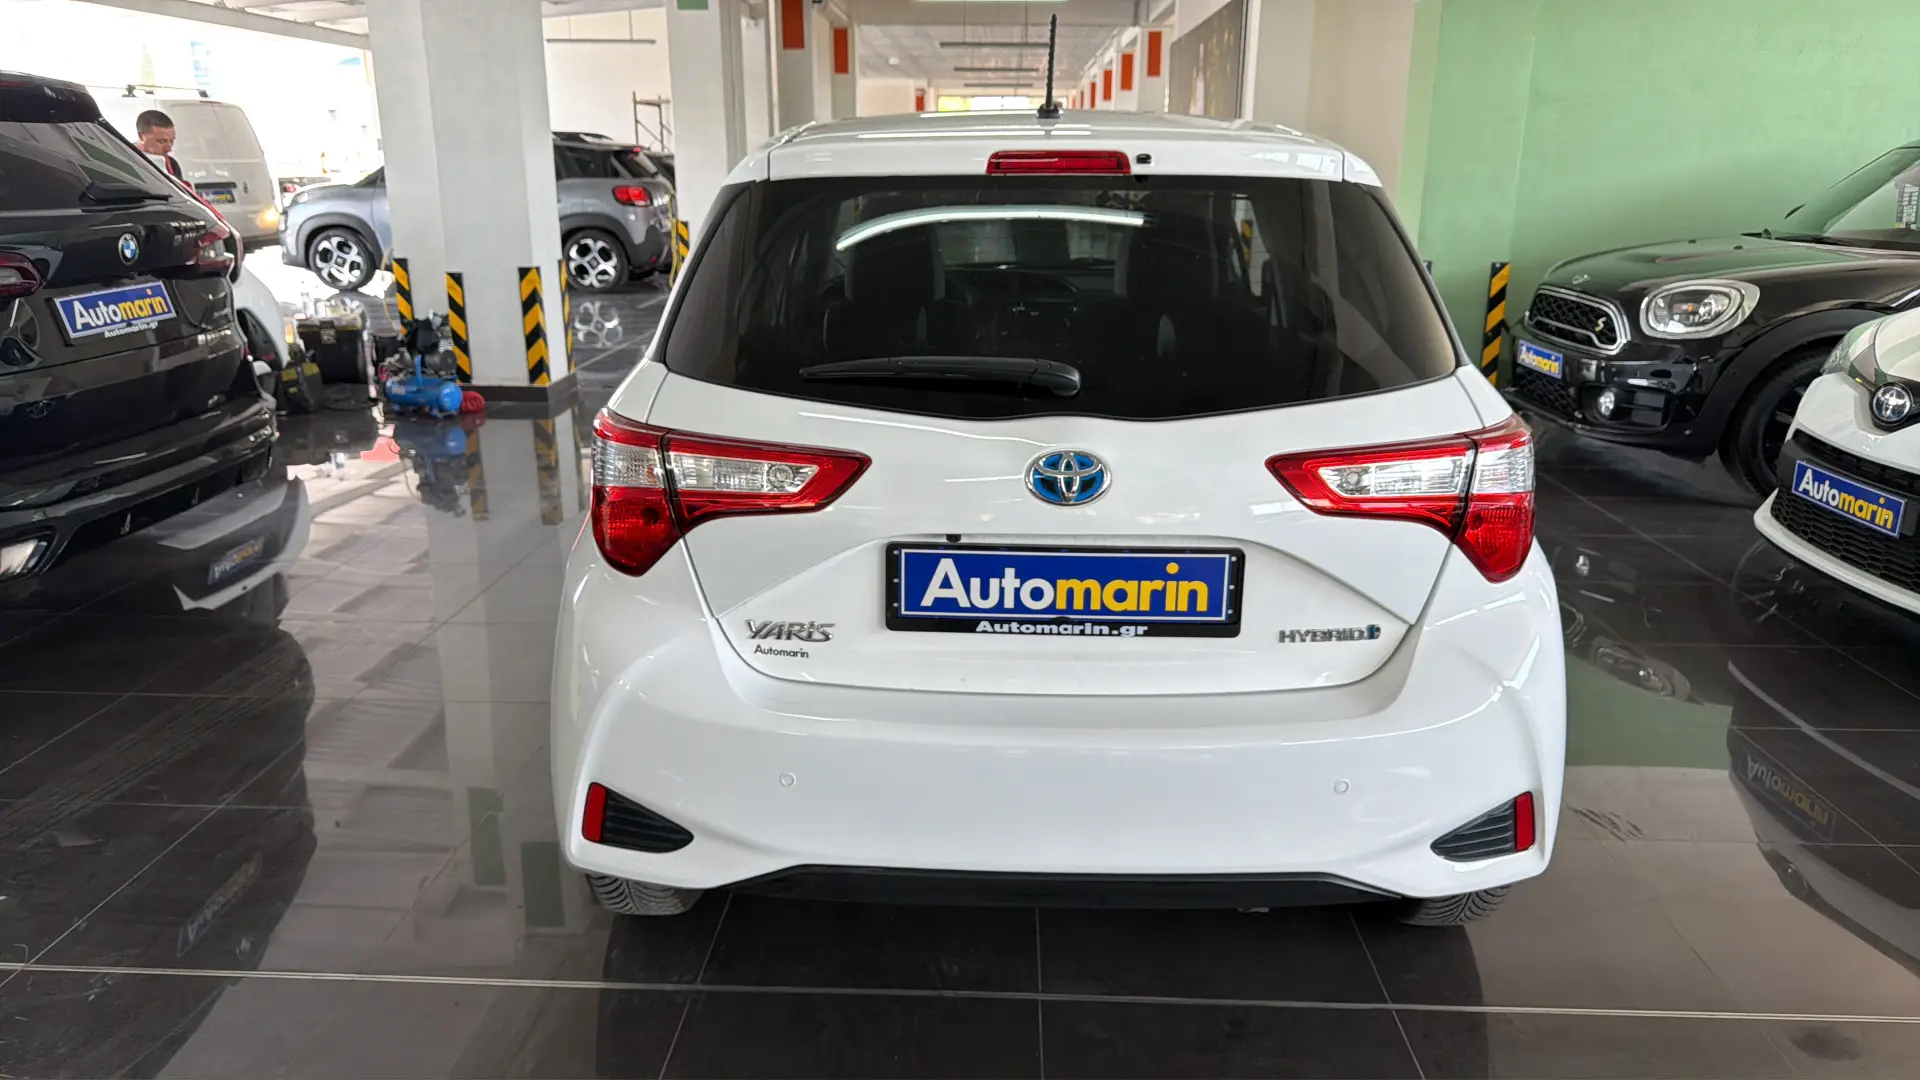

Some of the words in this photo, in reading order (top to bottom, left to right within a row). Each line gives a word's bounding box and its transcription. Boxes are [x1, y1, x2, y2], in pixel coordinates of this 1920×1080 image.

[72, 288, 169, 331] Automarin
[104, 320, 159, 339] Automarin.gr
[1798, 468, 1894, 530] Automarin
[920, 557, 1209, 613] Automarin
[975, 620, 1149, 637] Automarin.gr
[1278, 627, 1366, 643] HYBRID
[753, 644, 810, 659] Automarin
